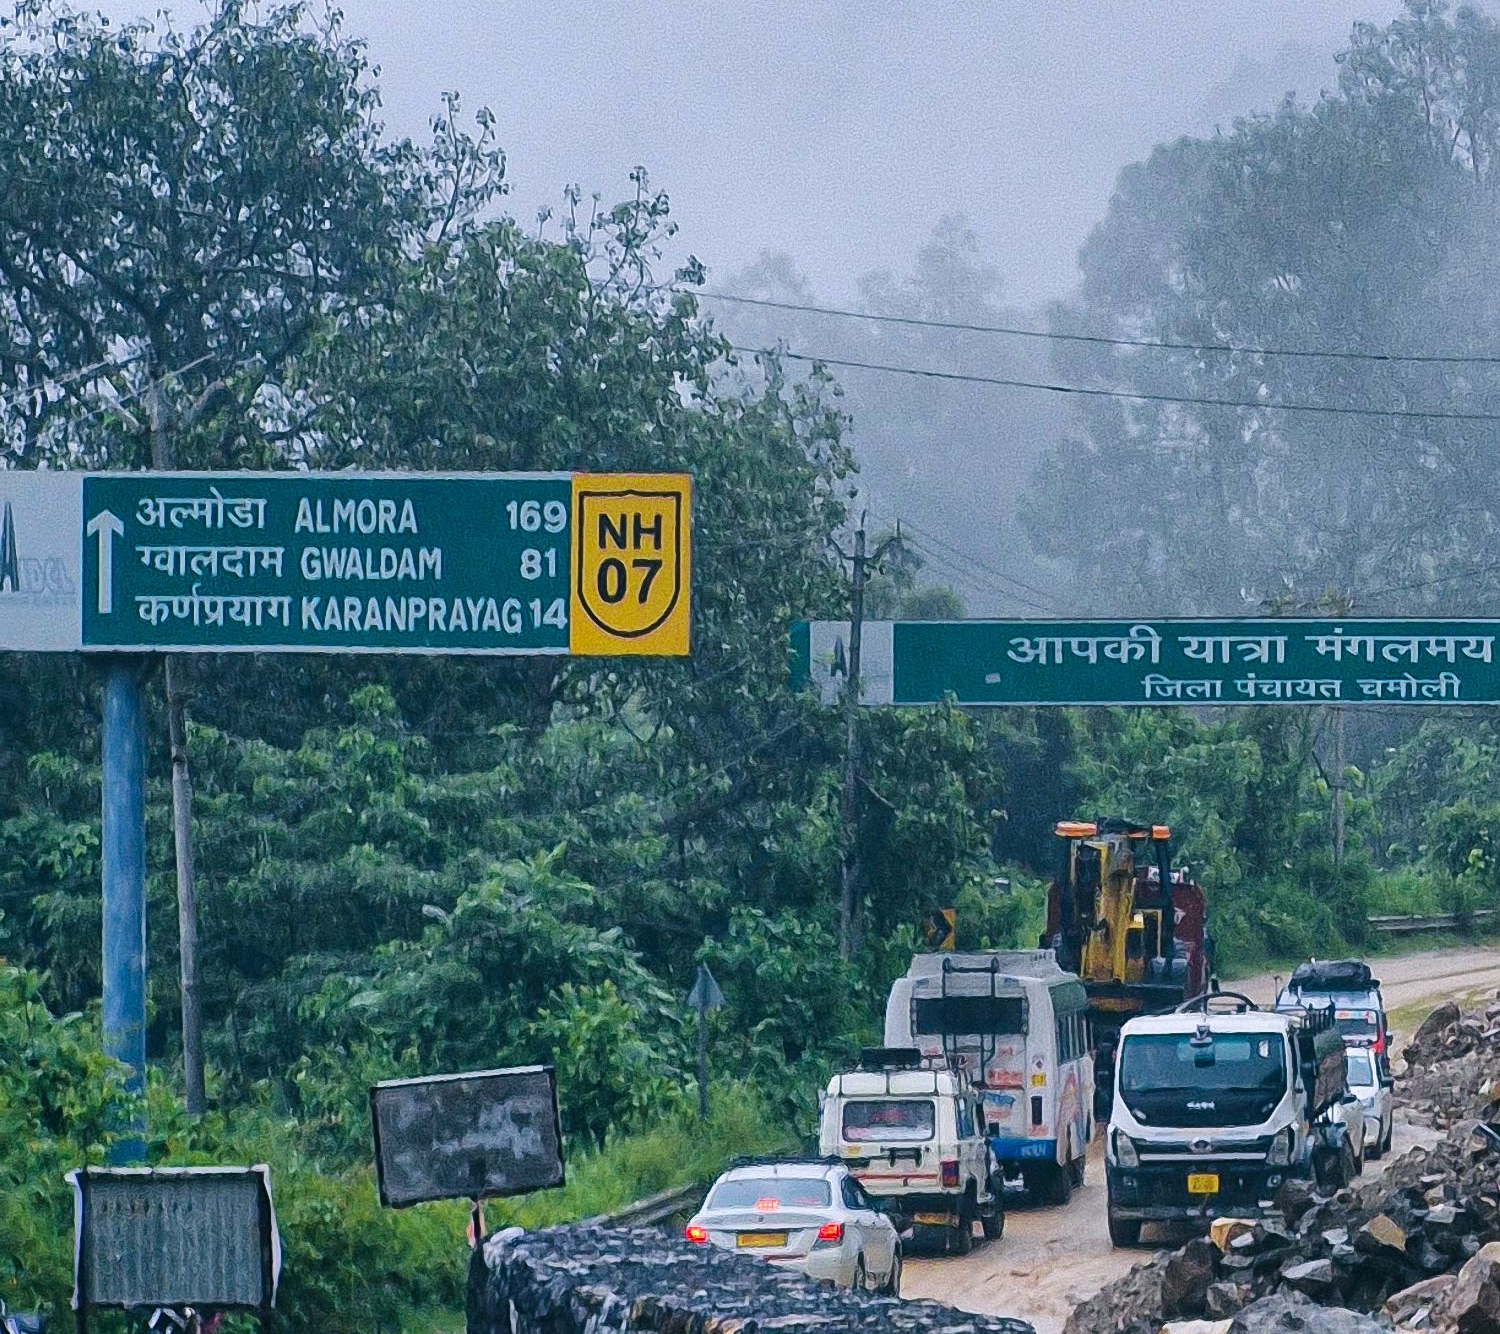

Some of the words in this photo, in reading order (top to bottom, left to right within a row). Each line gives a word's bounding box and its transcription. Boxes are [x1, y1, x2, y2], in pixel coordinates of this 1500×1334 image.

[294, 497, 418, 534] ALMORA
[506, 499, 567, 533] 169
[598, 512, 663, 550] NH
[301, 546, 442, 581] GWALDAM
[520, 548, 557, 581] 81
[597, 557, 663, 605] 07
[135, 582, 293, 627] कर्णप्रयाग
[302, 596, 523, 634] KARANPRAYAG
[529, 598, 568, 631] 14
[1007, 624, 1163, 665] आपकी
[1178, 635, 1289, 664] यात्रा
[1304, 627, 1496, 664] मंगलमय
[1141, 673, 1224, 699] जिला
[1233, 673, 1343, 699] पंचायत
[1356, 671, 1462, 699] चमोली
